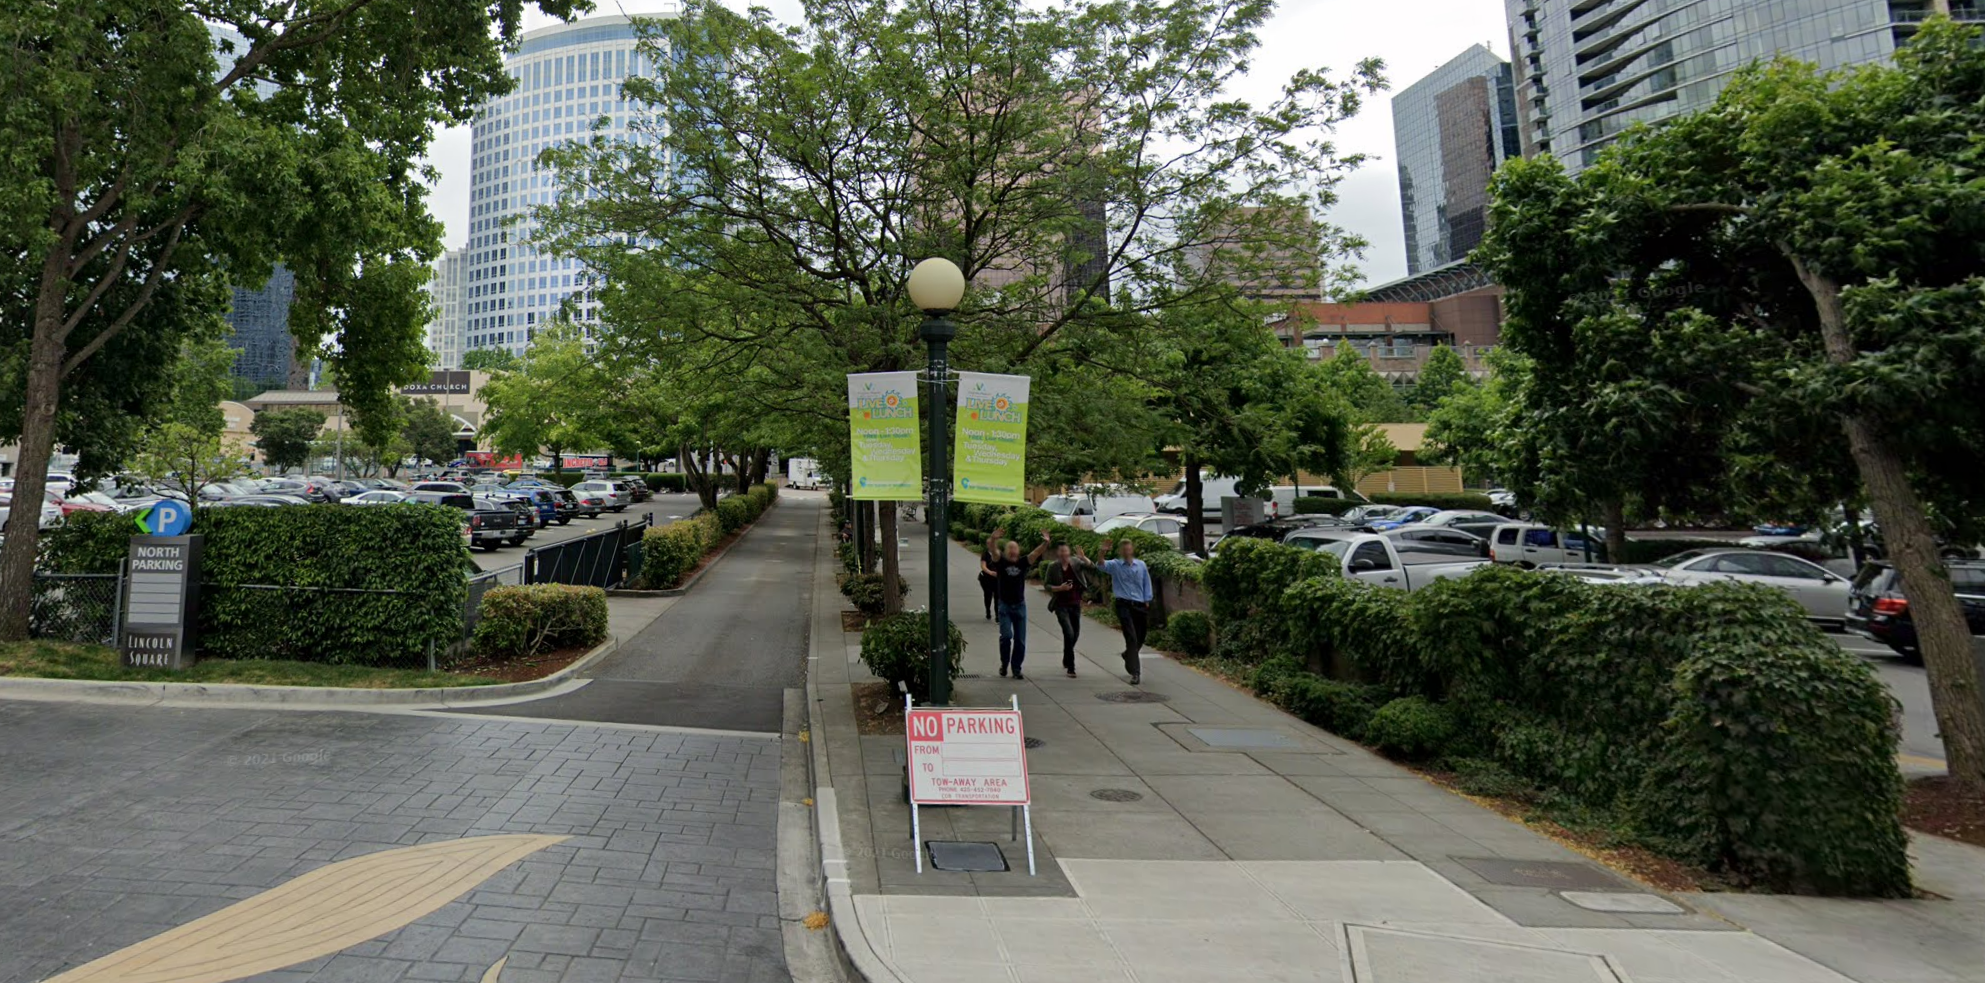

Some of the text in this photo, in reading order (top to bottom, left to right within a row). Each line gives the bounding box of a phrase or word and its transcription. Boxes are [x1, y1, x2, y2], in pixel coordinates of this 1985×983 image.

[857, 397, 884, 409] LIVE
[966, 397, 992, 410] LIVE
[871, 407, 913, 419] LUNCH
[979, 409, 1022, 424] LUNCH
[962, 427, 985, 437] Noon
[973, 456, 1007, 467] Thursday
[158, 507, 177, 533] P
[137, 546, 180, 558] NORTH
[132, 559, 183, 571] PARKING
[128, 635, 173, 649] LINCOLN
[129, 651, 169, 667] SQUARE
[913, 716, 1015, 738] NO PARKING
[914, 745, 940, 754] FROM
[922, 763, 934, 772] TO
[931, 778, 1007, 787] TOW-AWAY AREA
